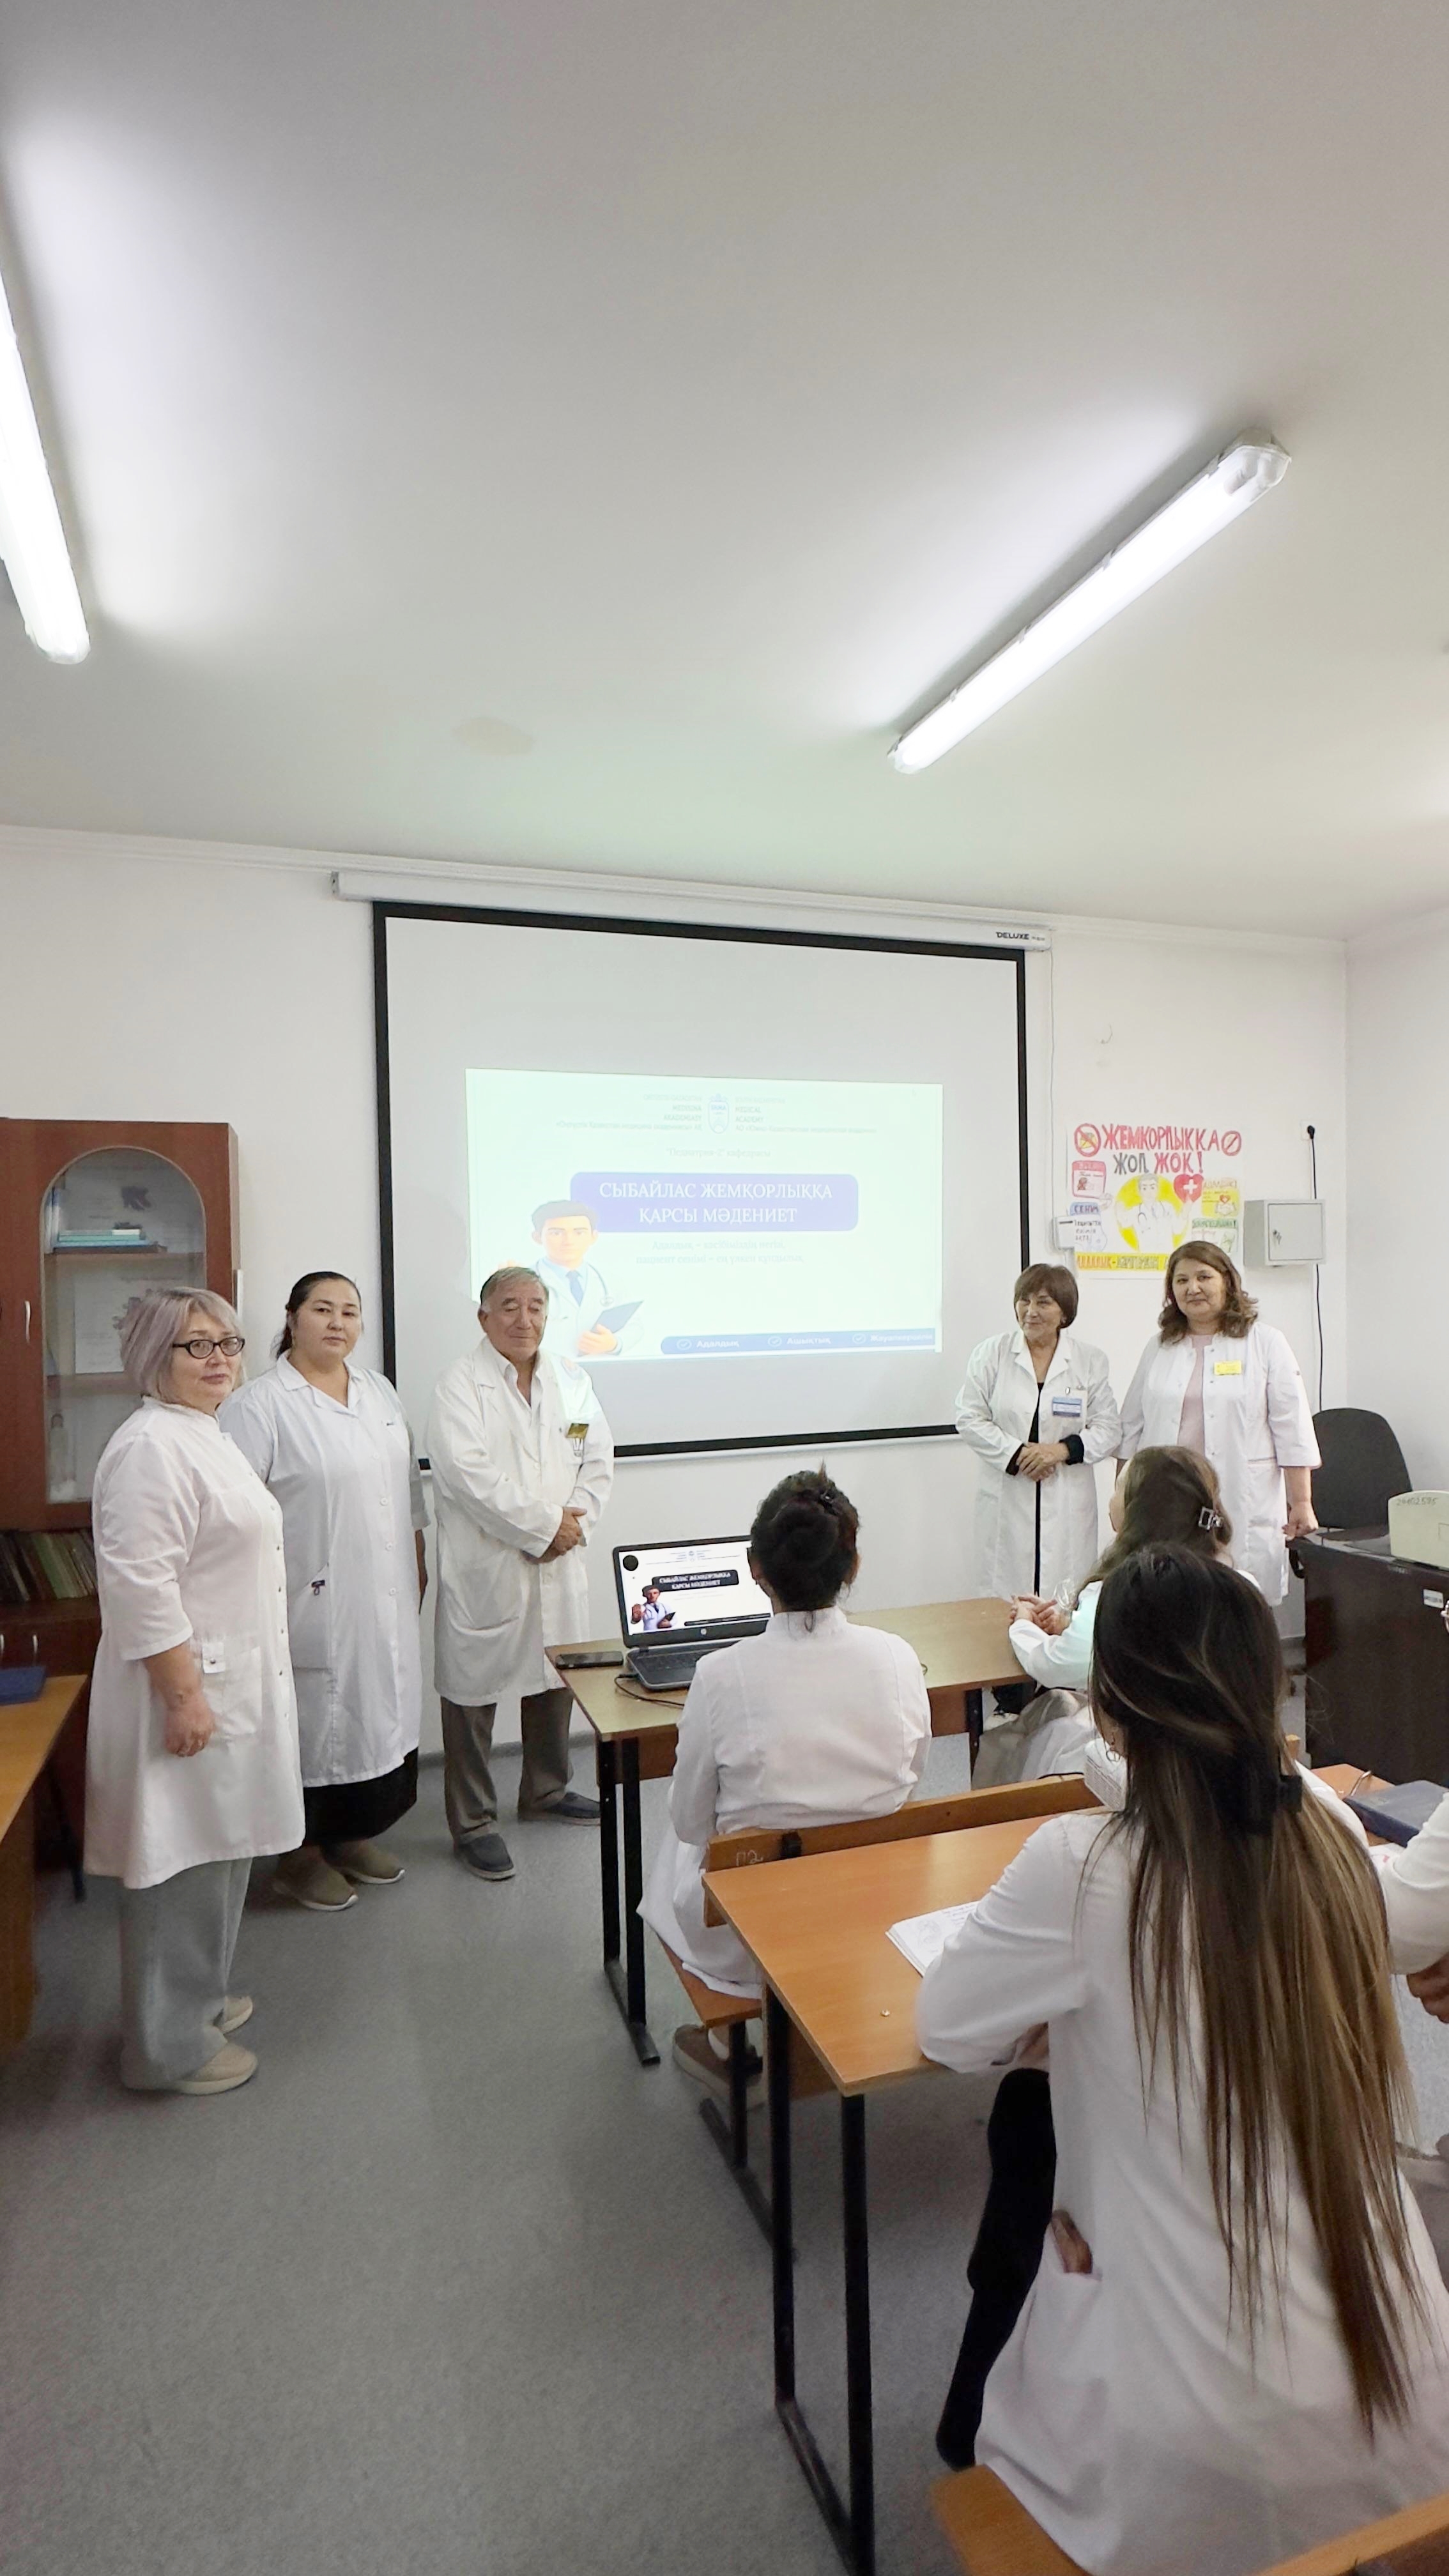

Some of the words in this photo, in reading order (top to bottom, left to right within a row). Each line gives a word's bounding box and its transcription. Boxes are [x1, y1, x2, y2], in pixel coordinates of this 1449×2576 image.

[995, 931, 1029, 940] DELUXE
[599, 1181, 696, 1198] СЫБАЙЛАС
[700, 1183, 833, 1201] ЖЕМҚОРЛЫҚҚА
[639, 1208, 698, 1225] ҚАРСЫ
[703, 1208, 798, 1225] МӘДЕНИЕТ
[696, 1339, 740, 1349] Адалдық
